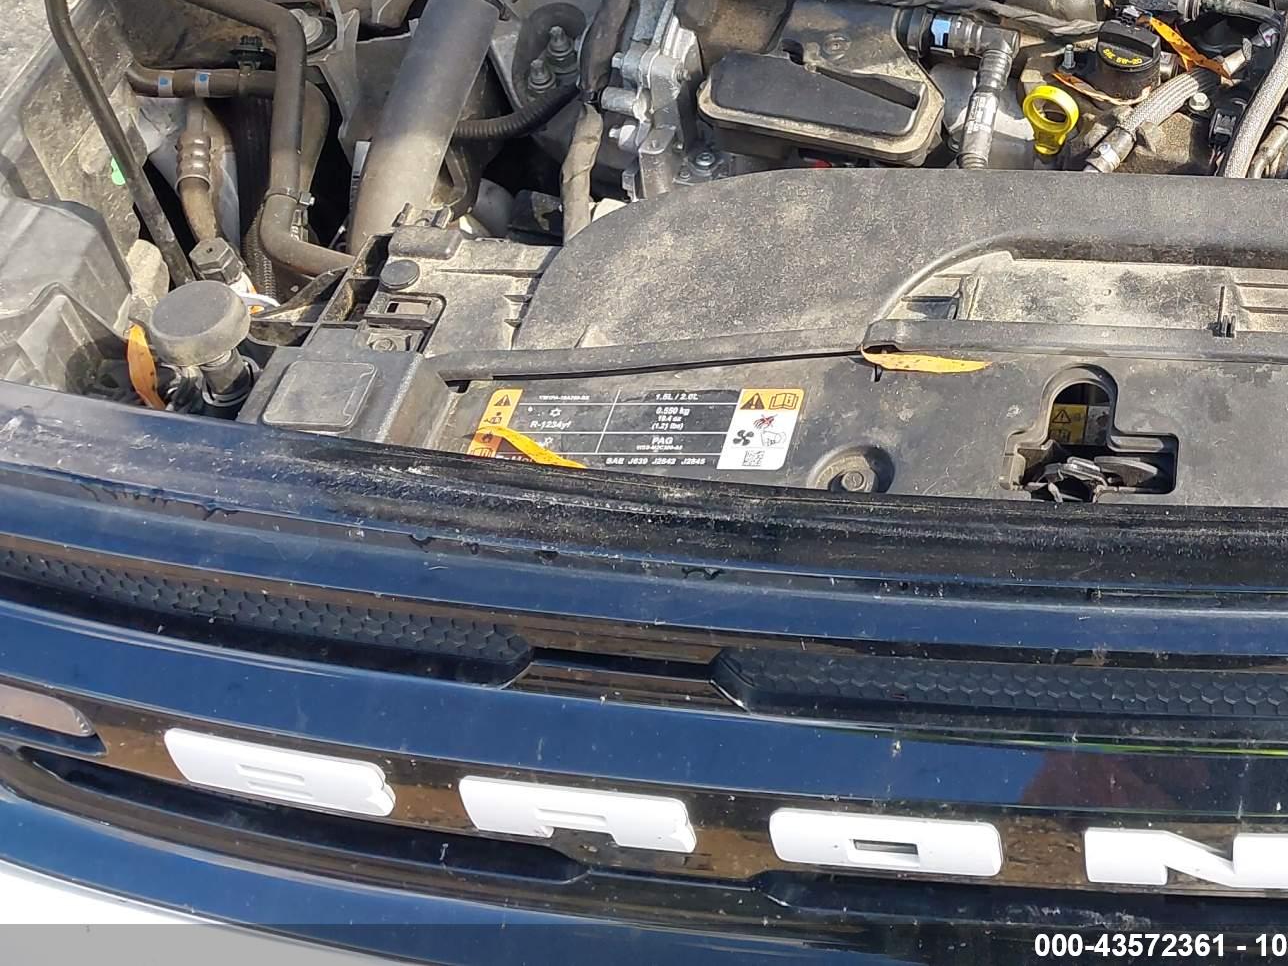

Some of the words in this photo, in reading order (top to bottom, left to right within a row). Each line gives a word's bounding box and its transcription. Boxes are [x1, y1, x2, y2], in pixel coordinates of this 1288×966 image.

[656, 393, 673, 401] 1.5L
[680, 393, 699, 401] 2.0L
[656, 406, 678, 415] 0.550
[679, 406, 690, 417] kg
[530, 420, 572, 430] R-1234yf
[652, 422, 669, 431] (1.21
[651, 436, 674, 445] PAG
[605, 457, 625, 465] SAE
[627, 457, 649, 465] J639
[651, 457, 677, 465] J2842
[680, 457, 706, 465] J2845
